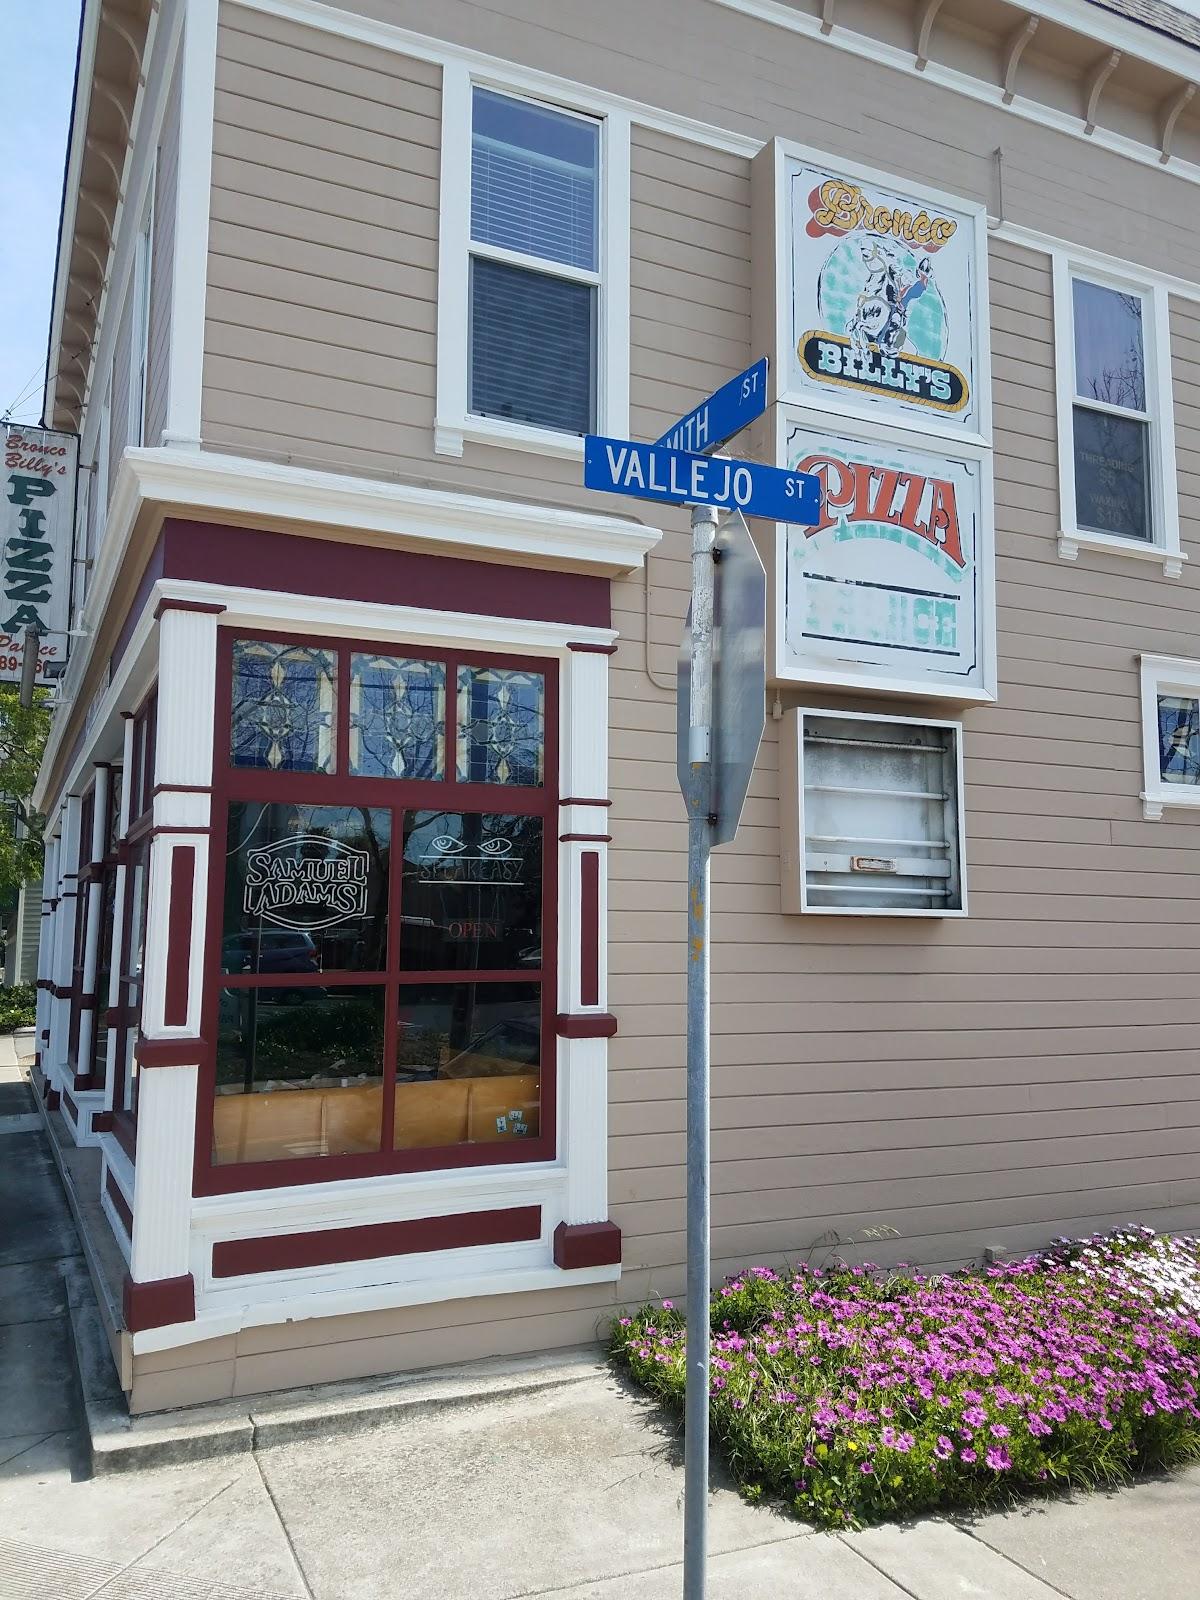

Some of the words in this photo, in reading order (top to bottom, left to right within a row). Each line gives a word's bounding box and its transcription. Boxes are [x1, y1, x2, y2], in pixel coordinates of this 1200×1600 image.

[814, 179, 958, 247] Bronco
[817, 341, 952, 400] BILLY'S
[658, 405, 710, 452] MITH
[742, 371, 759, 399] ST
[4, 452, 67, 475] Billy's
[5, 434, 67, 456] Bronco
[606, 445, 753, 506] VALLEJO
[784, 477, 805, 499] ST
[795, 454, 967, 569] PIZZA
[1, 474, 57, 636] PIZZA
[246, 852, 367, 886] SAMUEL
[253, 883, 359, 916] ADAMS
[448, 922, 498, 938] OPEN
